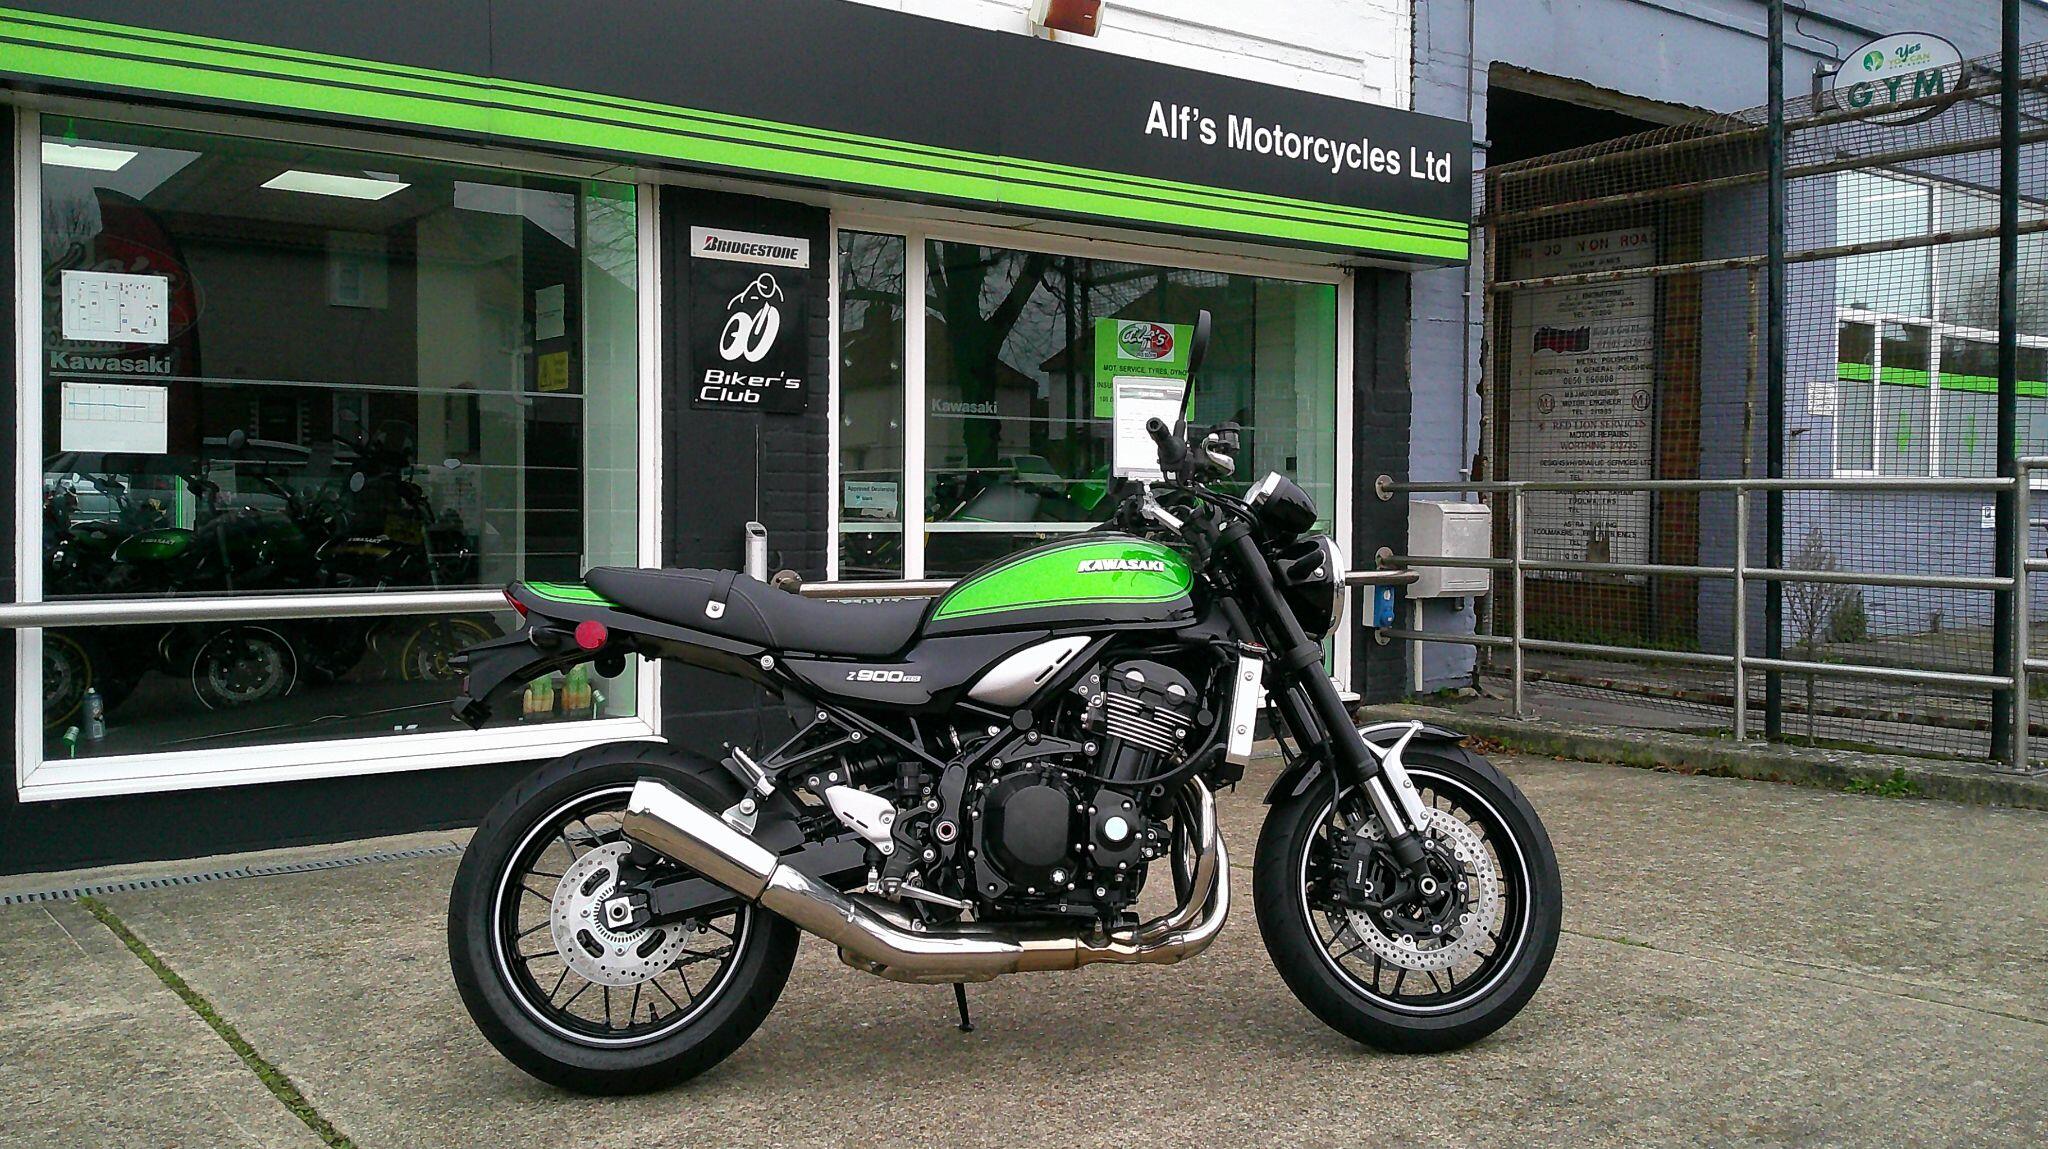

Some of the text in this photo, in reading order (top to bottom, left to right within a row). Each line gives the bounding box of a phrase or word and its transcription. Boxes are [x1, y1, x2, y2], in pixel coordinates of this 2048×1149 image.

[1895, 43, 1921, 62] Yes
[1848, 68, 1945, 107] GYM
[1145, 100, 1451, 183] Alf's Motorcycles Ltd
[703, 236, 799, 260] BRIDGESTONE
[50, 351, 171, 374] Kawasaki
[704, 370, 800, 389] Biker's
[700, 386, 760, 403] Club
[931, 398, 998, 414] Kawasaki
[1600, 419, 1647, 428] SERVICES
[1560, 441, 1606, 449] WORTHING
[1078, 559, 1164, 573] KAWASAKI
